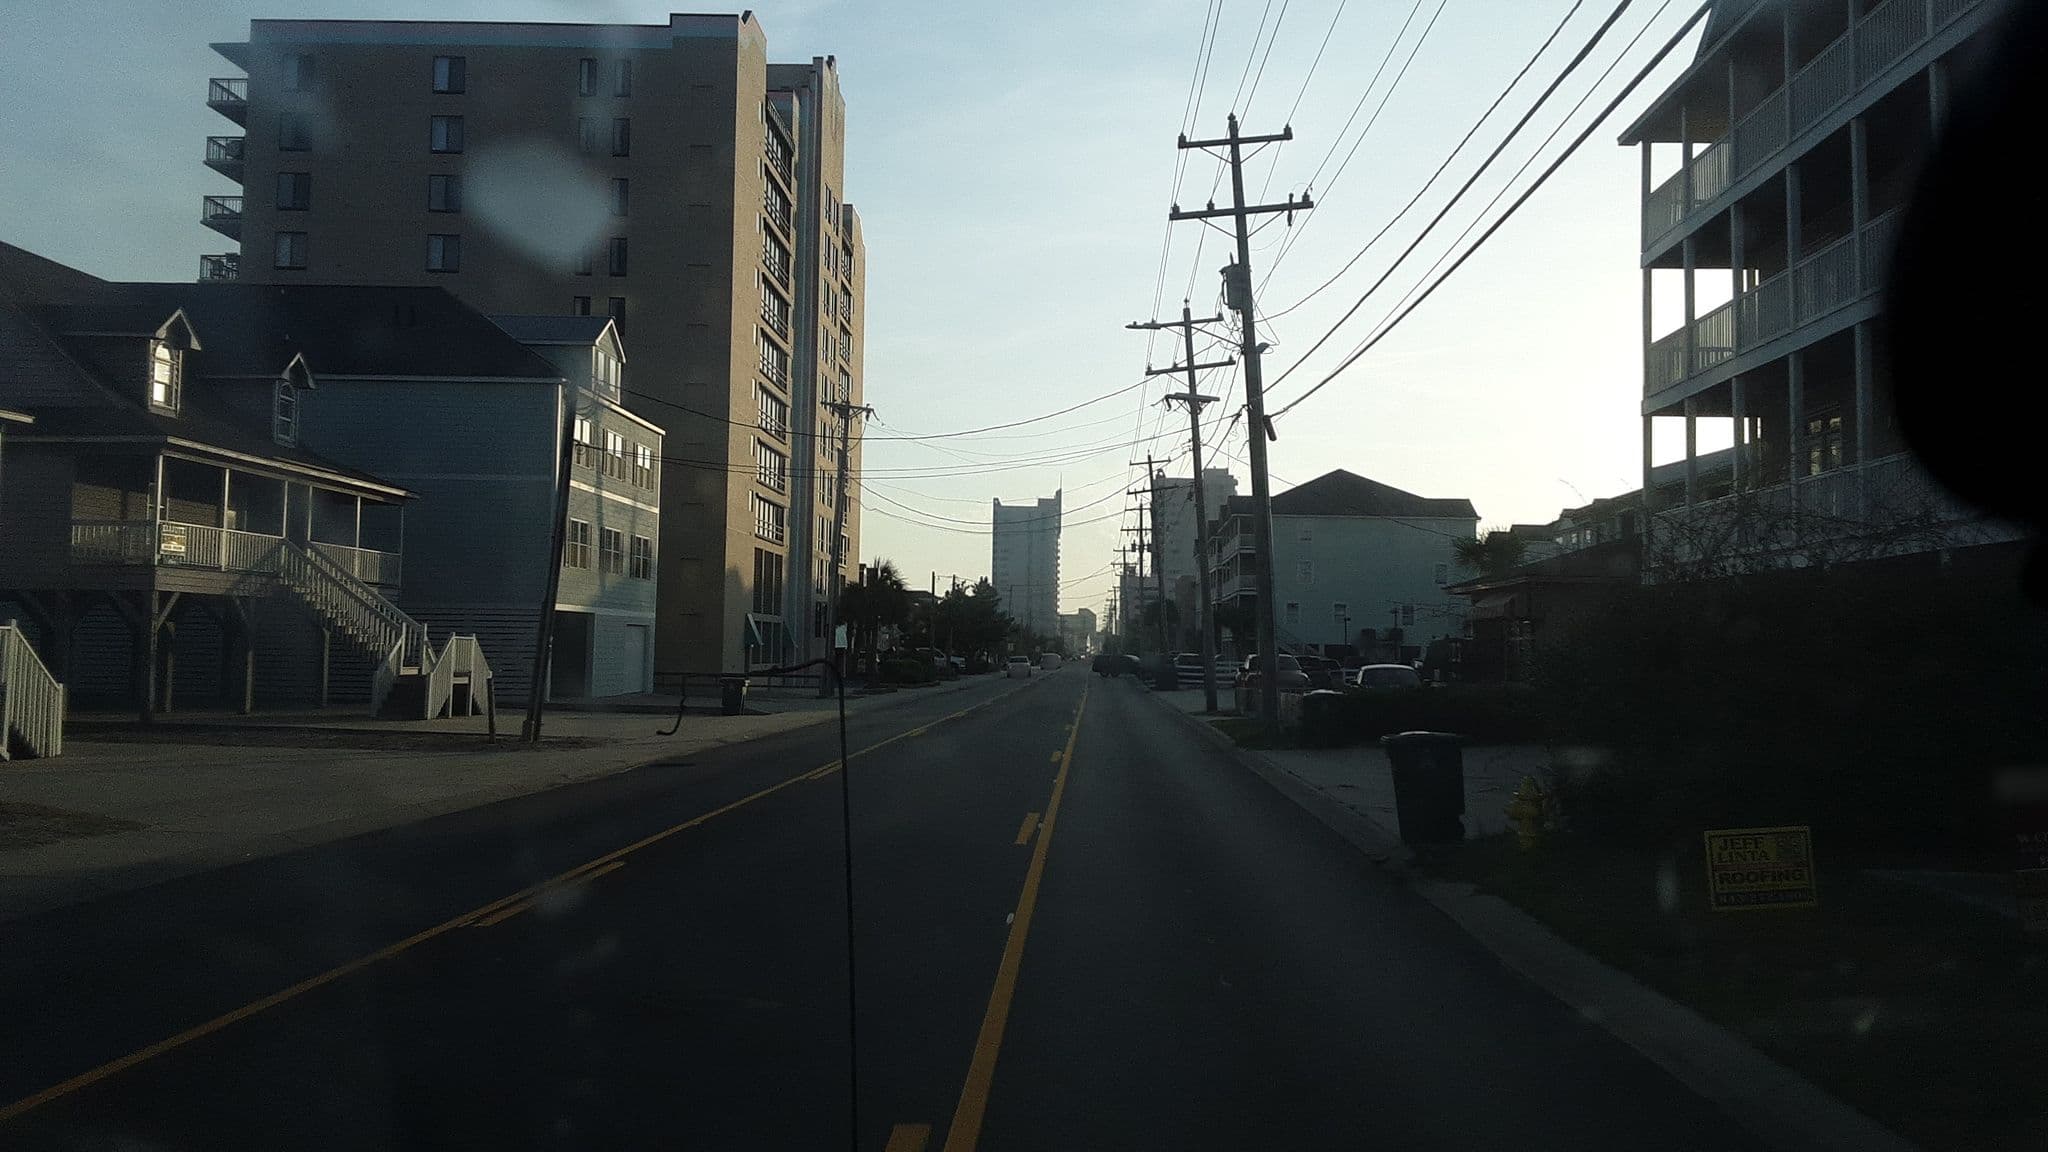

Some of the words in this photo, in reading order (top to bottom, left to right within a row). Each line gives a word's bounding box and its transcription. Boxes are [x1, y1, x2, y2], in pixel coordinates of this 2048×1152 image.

[1718, 837, 1763, 850] JEFF
[1717, 850, 1769, 864] LINTA
[1718, 869, 1803, 885] ROOFING
